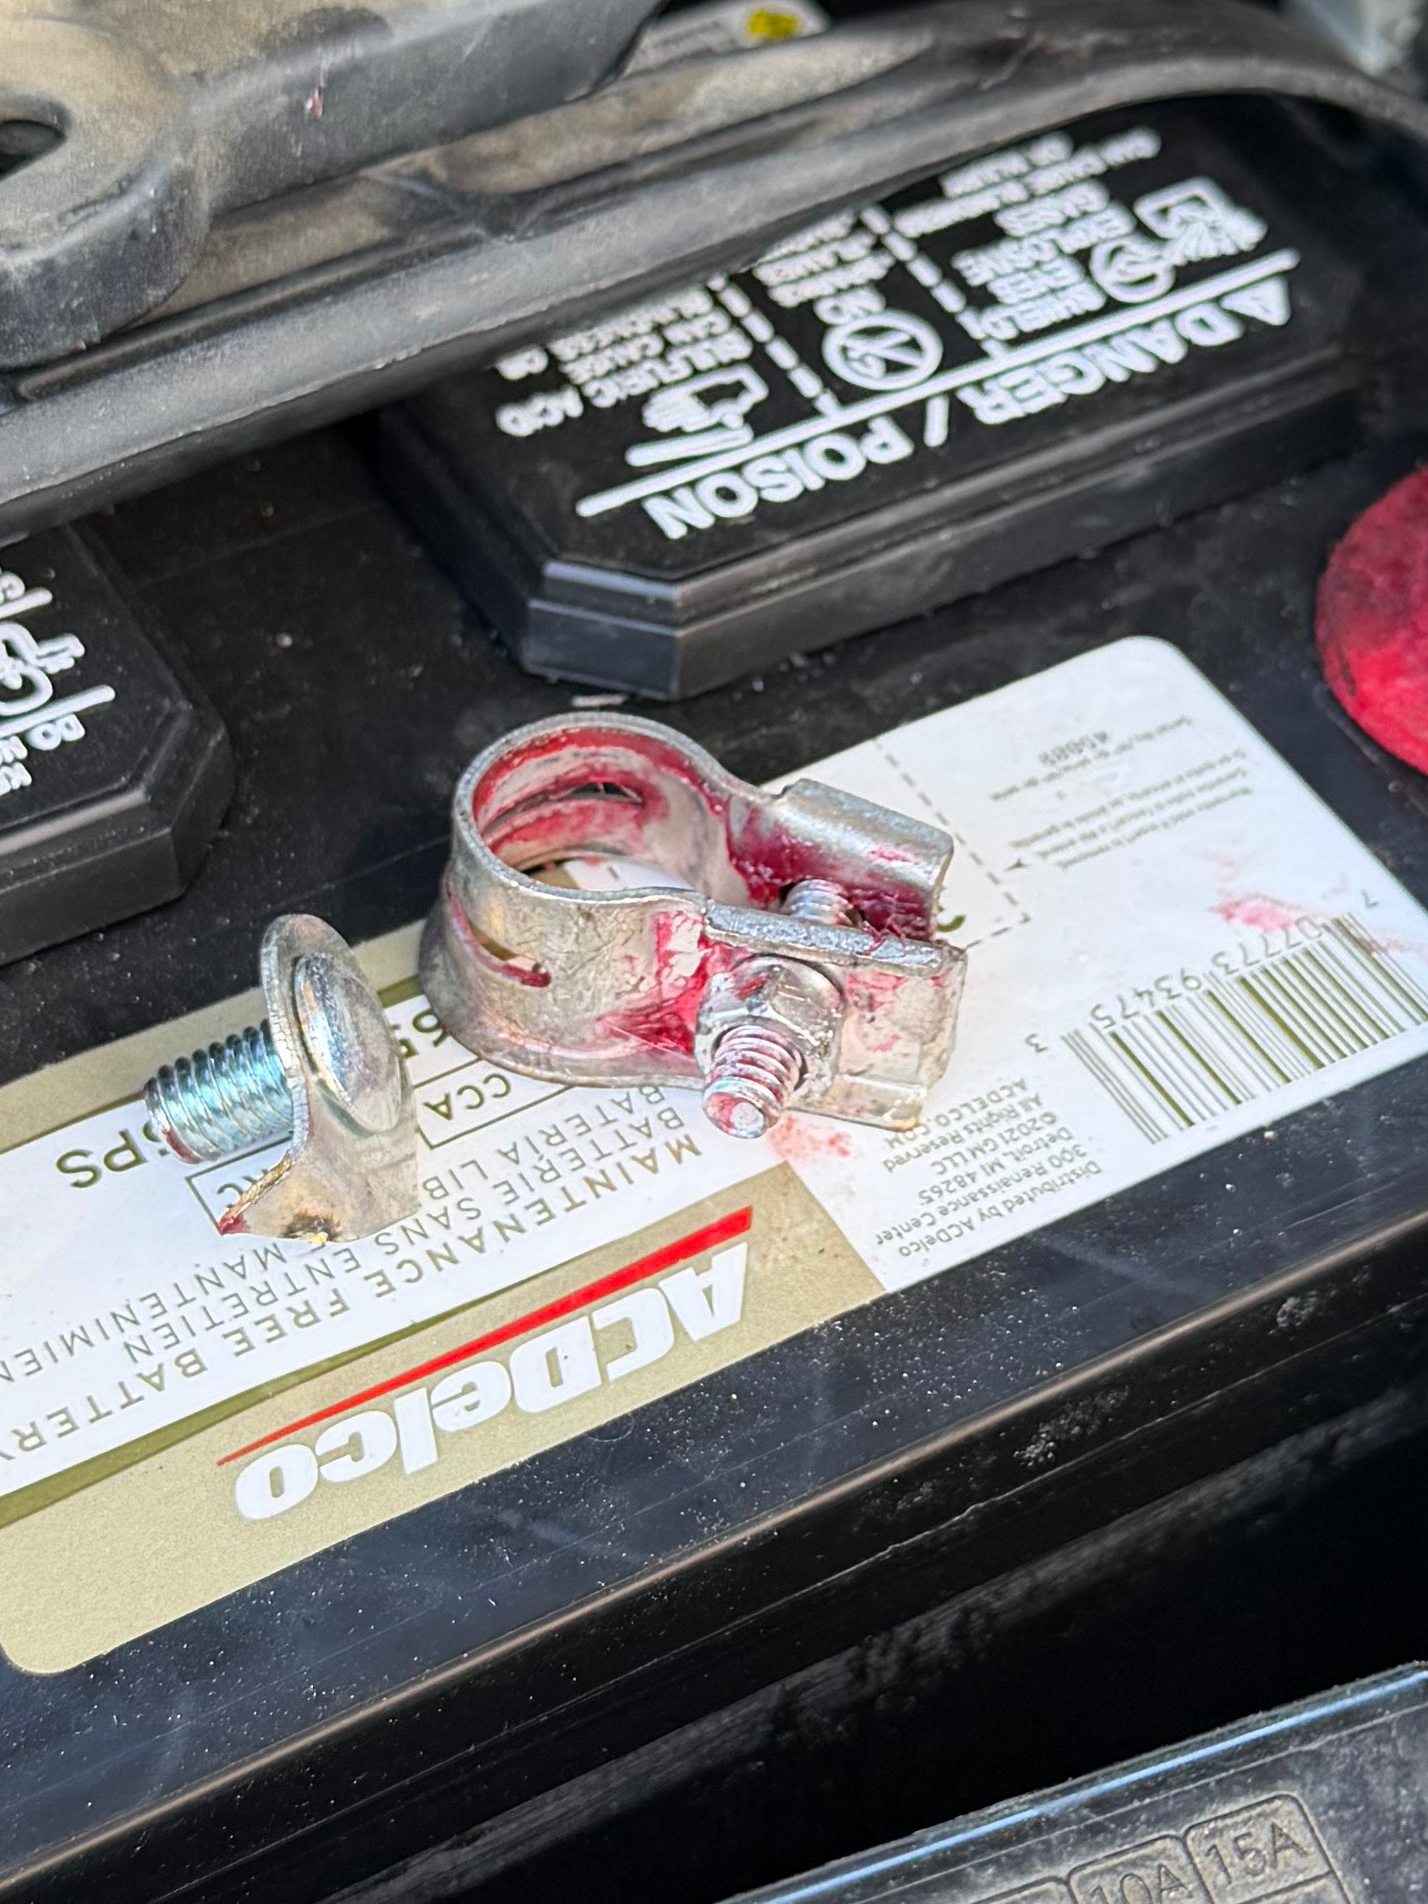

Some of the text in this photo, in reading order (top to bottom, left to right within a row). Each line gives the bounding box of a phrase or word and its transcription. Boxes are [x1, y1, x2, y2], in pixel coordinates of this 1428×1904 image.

[953, 197, 1135, 288] EXPLOSIVE
[995, 181, 1116, 246] GASES
[561, 307, 735, 385] CAN CAUSE
[814, 281, 886, 333] NO
[971, 271, 1107, 350] SHIELD
[496, 326, 753, 437] SULFURIC ACID
[961, 310, 1231, 425] DANGER
[645, 414, 914, 540] POISON
[20, 710, 86, 751] DO
[1024, 890, 1380, 1054] 7 07773 93475 3
[423, 1073, 512, 1121] CCA
[495, 1079, 667, 1166] BATERÍA
[882, 1092, 1043, 1174] All Rights Reserved
[884, 1077, 1028, 1150] ACDELCO.COM
[421, 1159, 489, 1201] LIB
[917, 1126, 1074, 1206] Detroit, MI 48265
[930, 1151, 970, 1176] LLC
[966, 1137, 999, 1160] GM
[362, 1133, 702, 1299] MAINTENANCE
[875, 1143, 1088, 1246] 300 Renaissance Center
[897, 1160, 1103, 1258] Distributed by ACDelco
[122, 1106, 686, 1364] BATTERIE SANS ENTRETIEN
[221, 1287, 351, 1358] FREE
[233, 1241, 753, 1523] ACDelco
[1204, 1820, 1307, 1884] 15A
